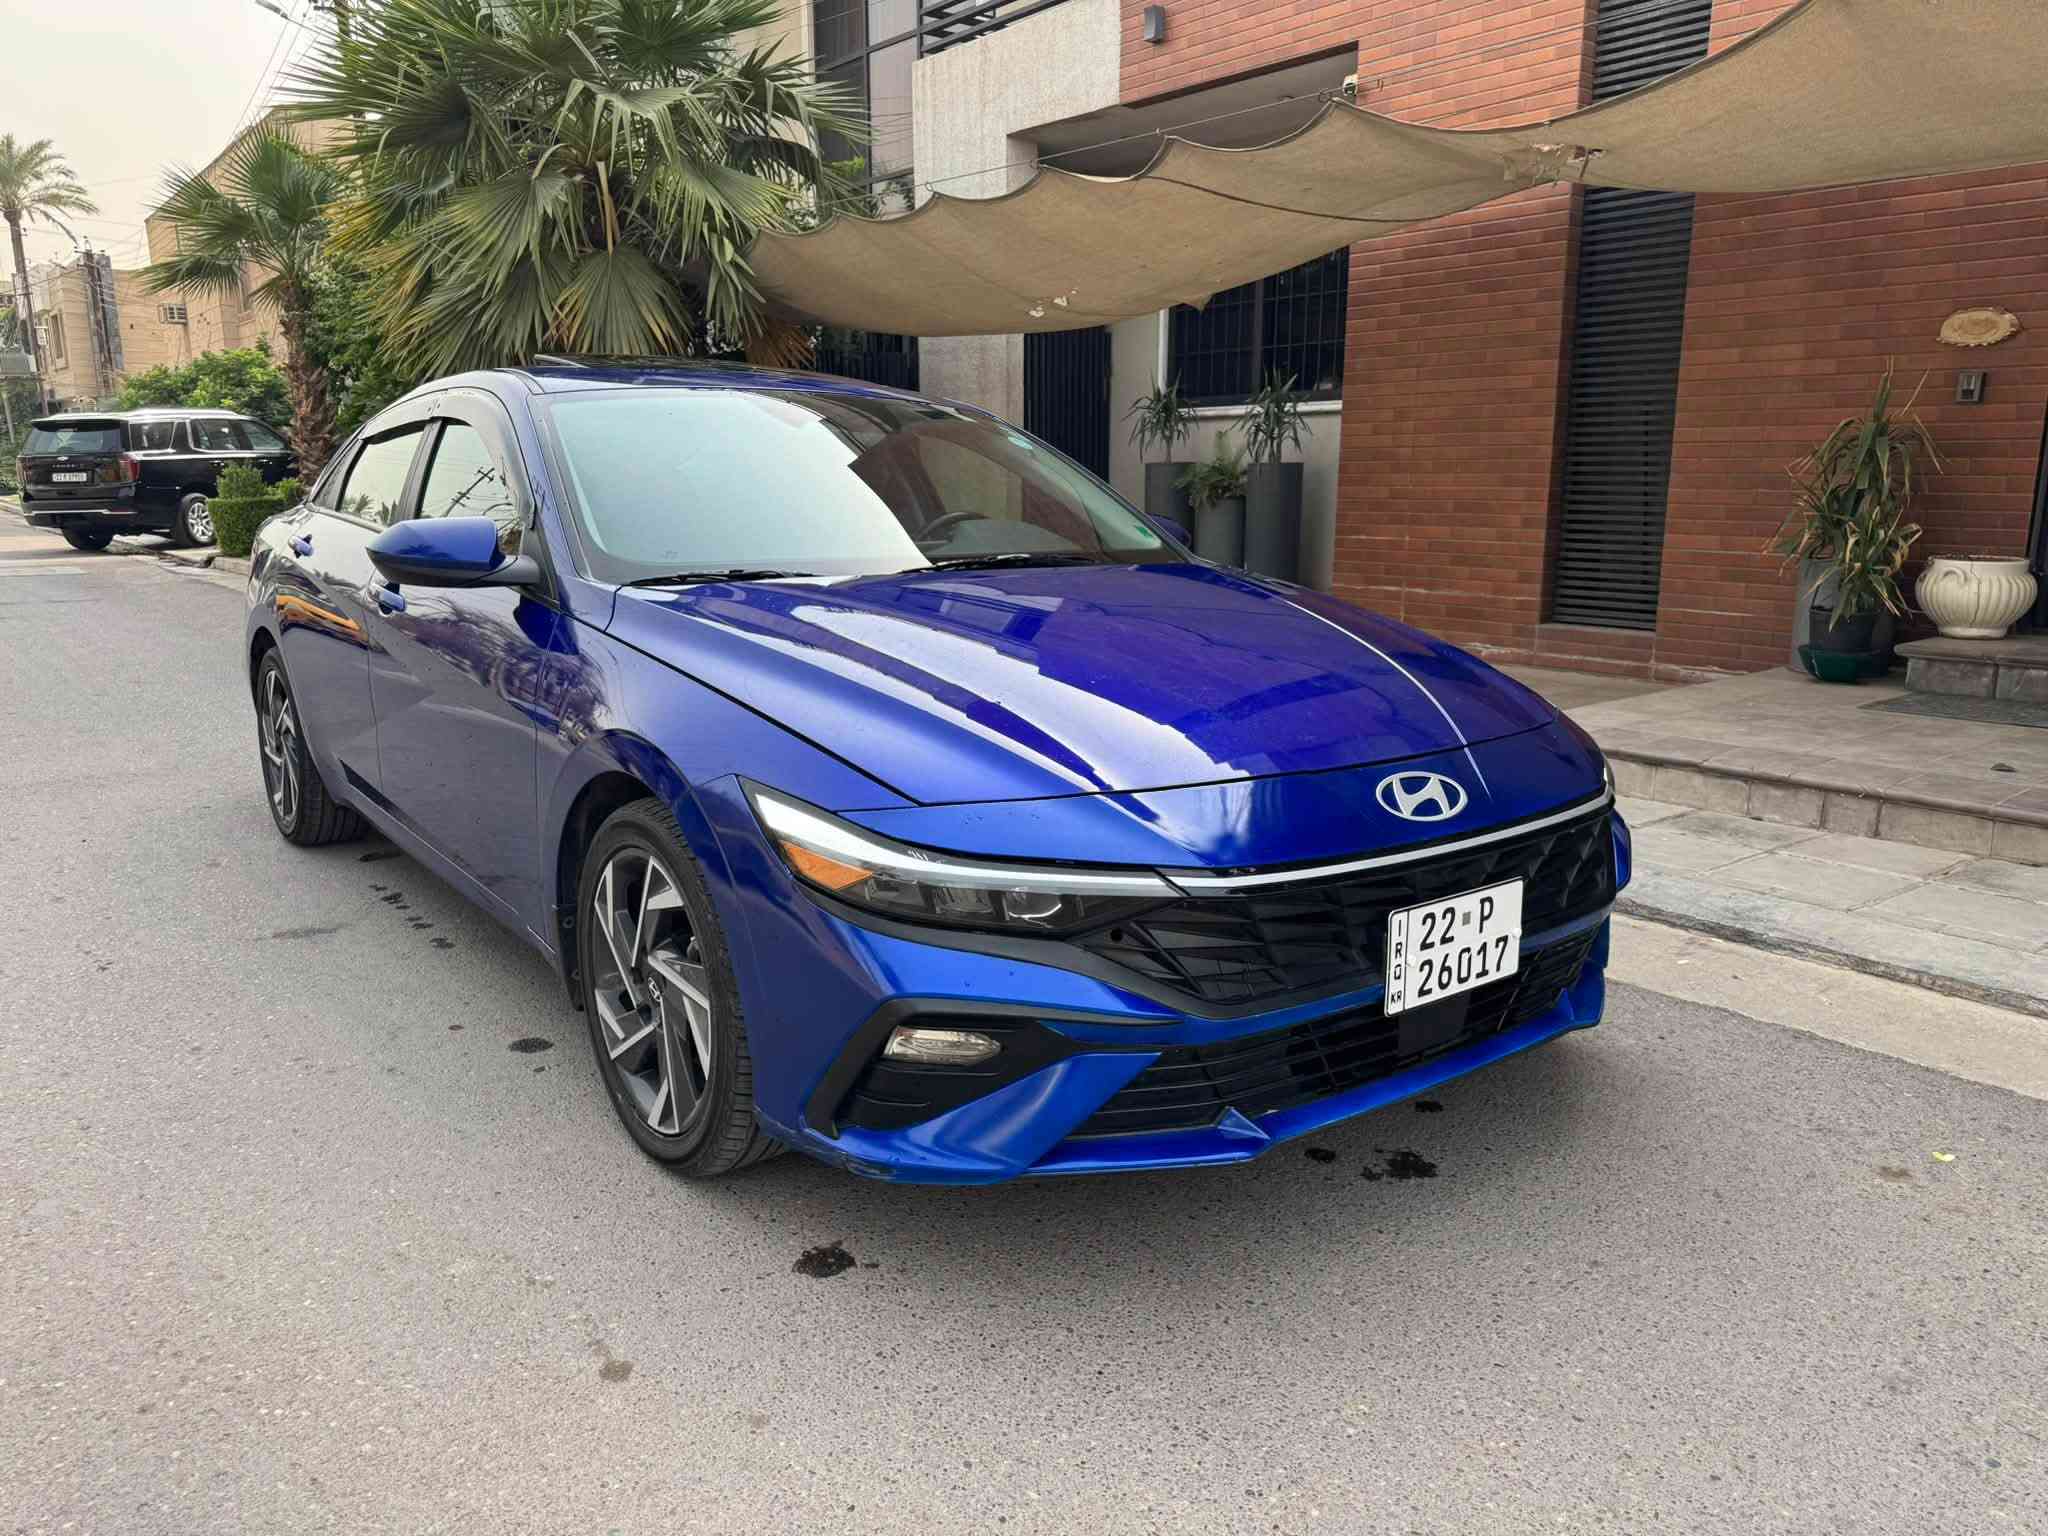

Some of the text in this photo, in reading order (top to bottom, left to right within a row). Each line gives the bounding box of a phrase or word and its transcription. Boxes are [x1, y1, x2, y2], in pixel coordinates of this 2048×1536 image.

[1420, 895, 1494, 951] 22 P
[1417, 934, 1509, 998] 26017
